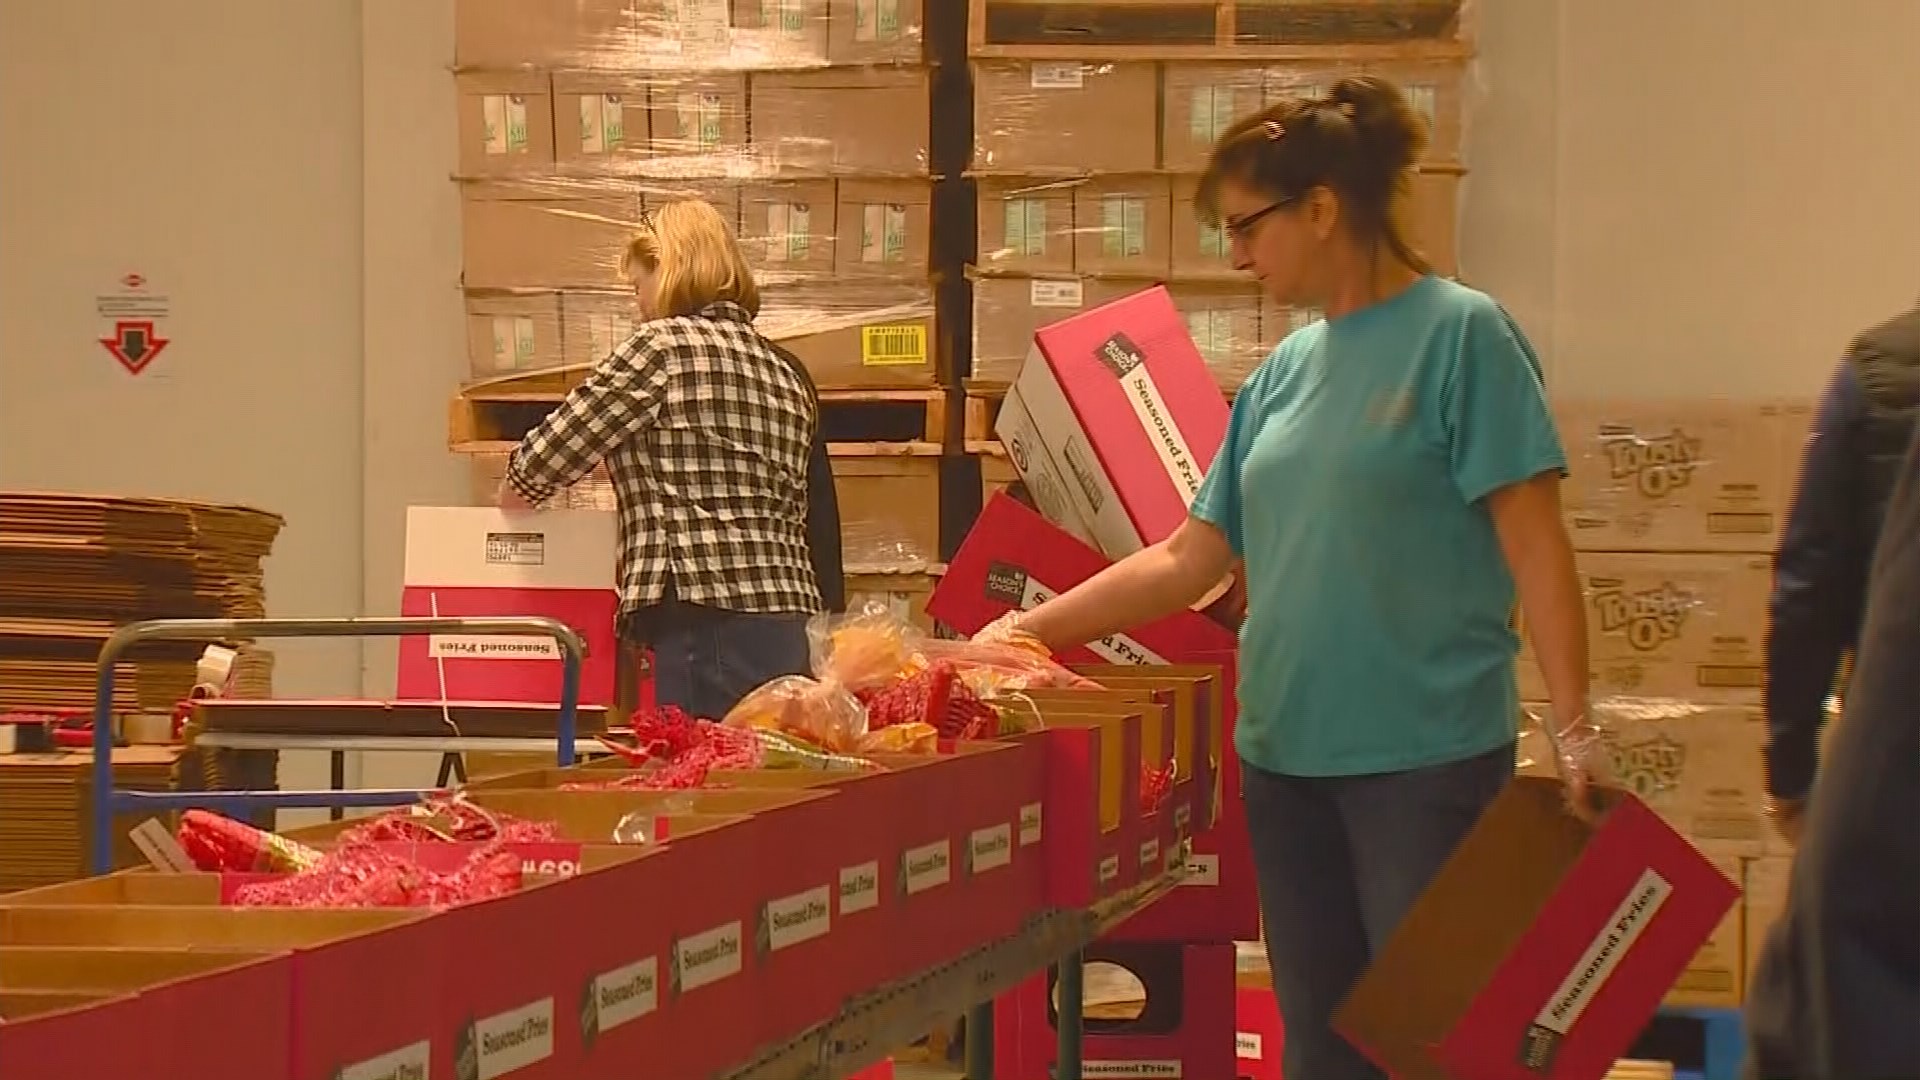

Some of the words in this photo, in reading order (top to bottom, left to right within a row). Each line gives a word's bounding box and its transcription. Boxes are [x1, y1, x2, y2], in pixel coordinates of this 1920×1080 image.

[1134, 378, 1182, 457] Seasoned
[1176, 458, 1199, 493] Frie
[439, 642, 477, 654] Fries
[481, 643, 551, 654] Seasoned
[1114, 642, 1150, 666] Fri
[1552, 934, 1620, 1020] Seasoned
[1616, 886, 1657, 932] Fries
[483, 1021, 526, 1055] Seasoned
[527, 1016, 549, 1039] Fries
[1237, 1037, 1257, 1049] ries
[1084, 1064, 1139, 1073] easoned
